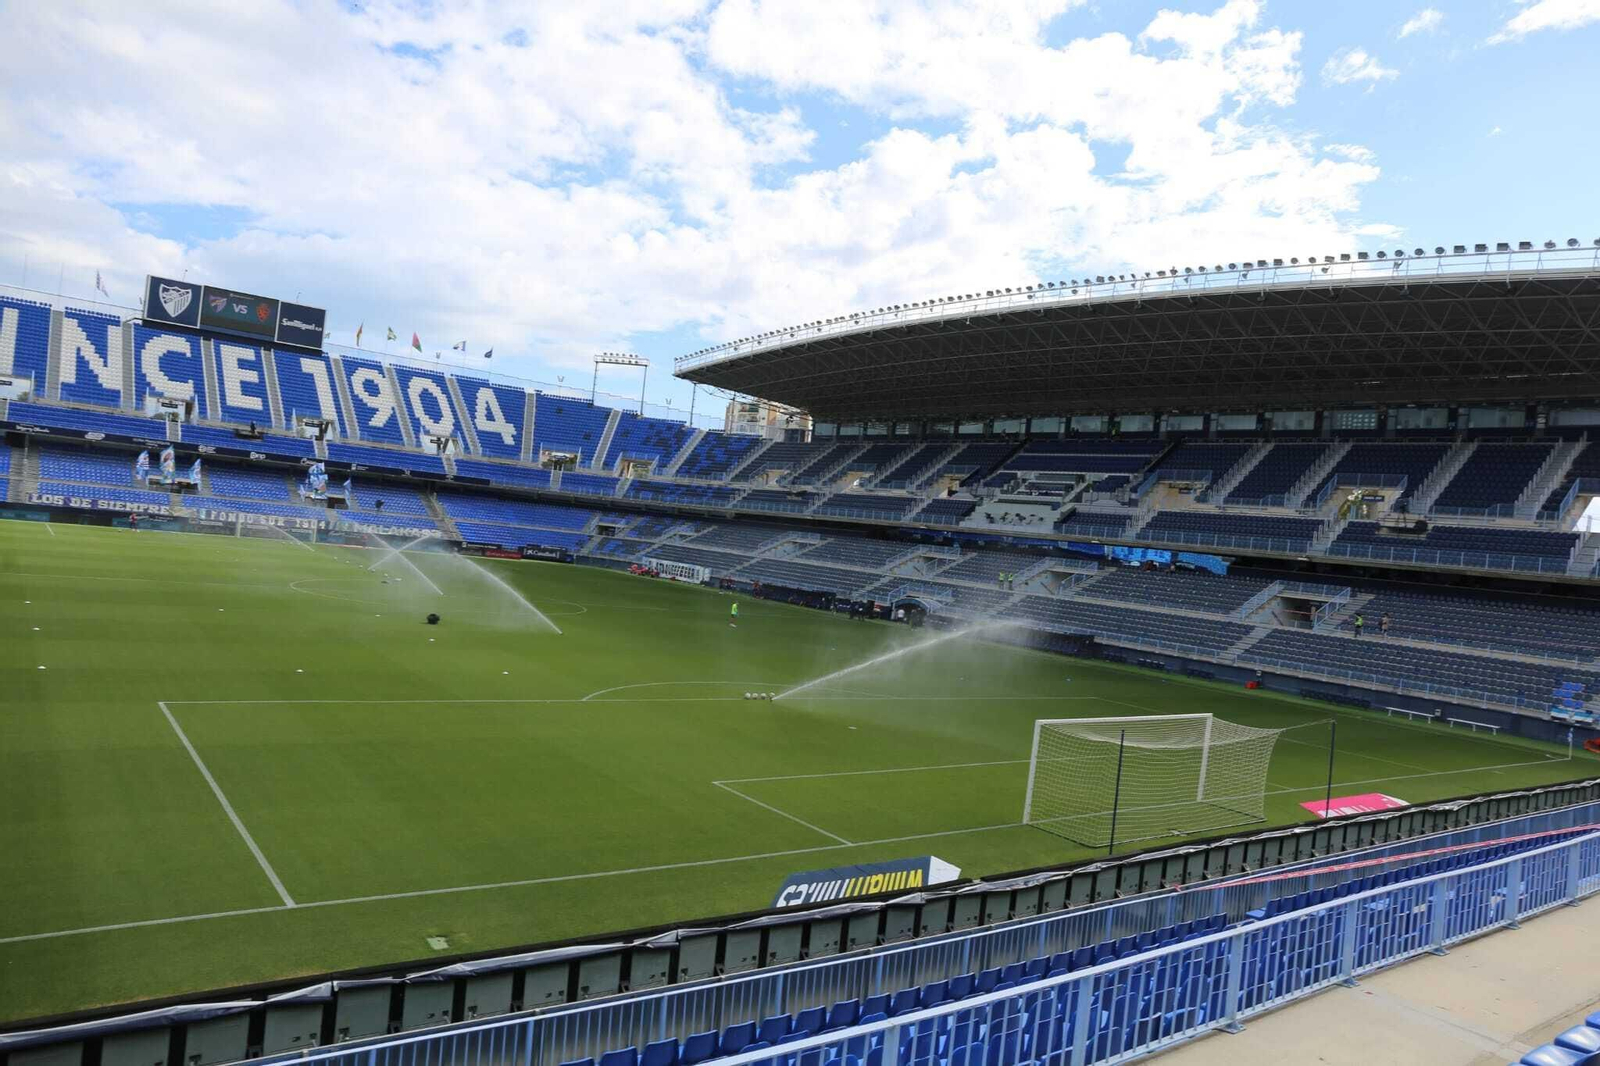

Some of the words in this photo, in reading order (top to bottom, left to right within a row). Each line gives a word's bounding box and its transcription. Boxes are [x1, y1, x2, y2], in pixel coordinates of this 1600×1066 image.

[232, 303, 248, 314] VS
[300, 356, 517, 446] 1904
[31, 493, 65, 504] LOS
[69, 496, 92, 507] DE
[97, 499, 171, 515] SIEMPRE
